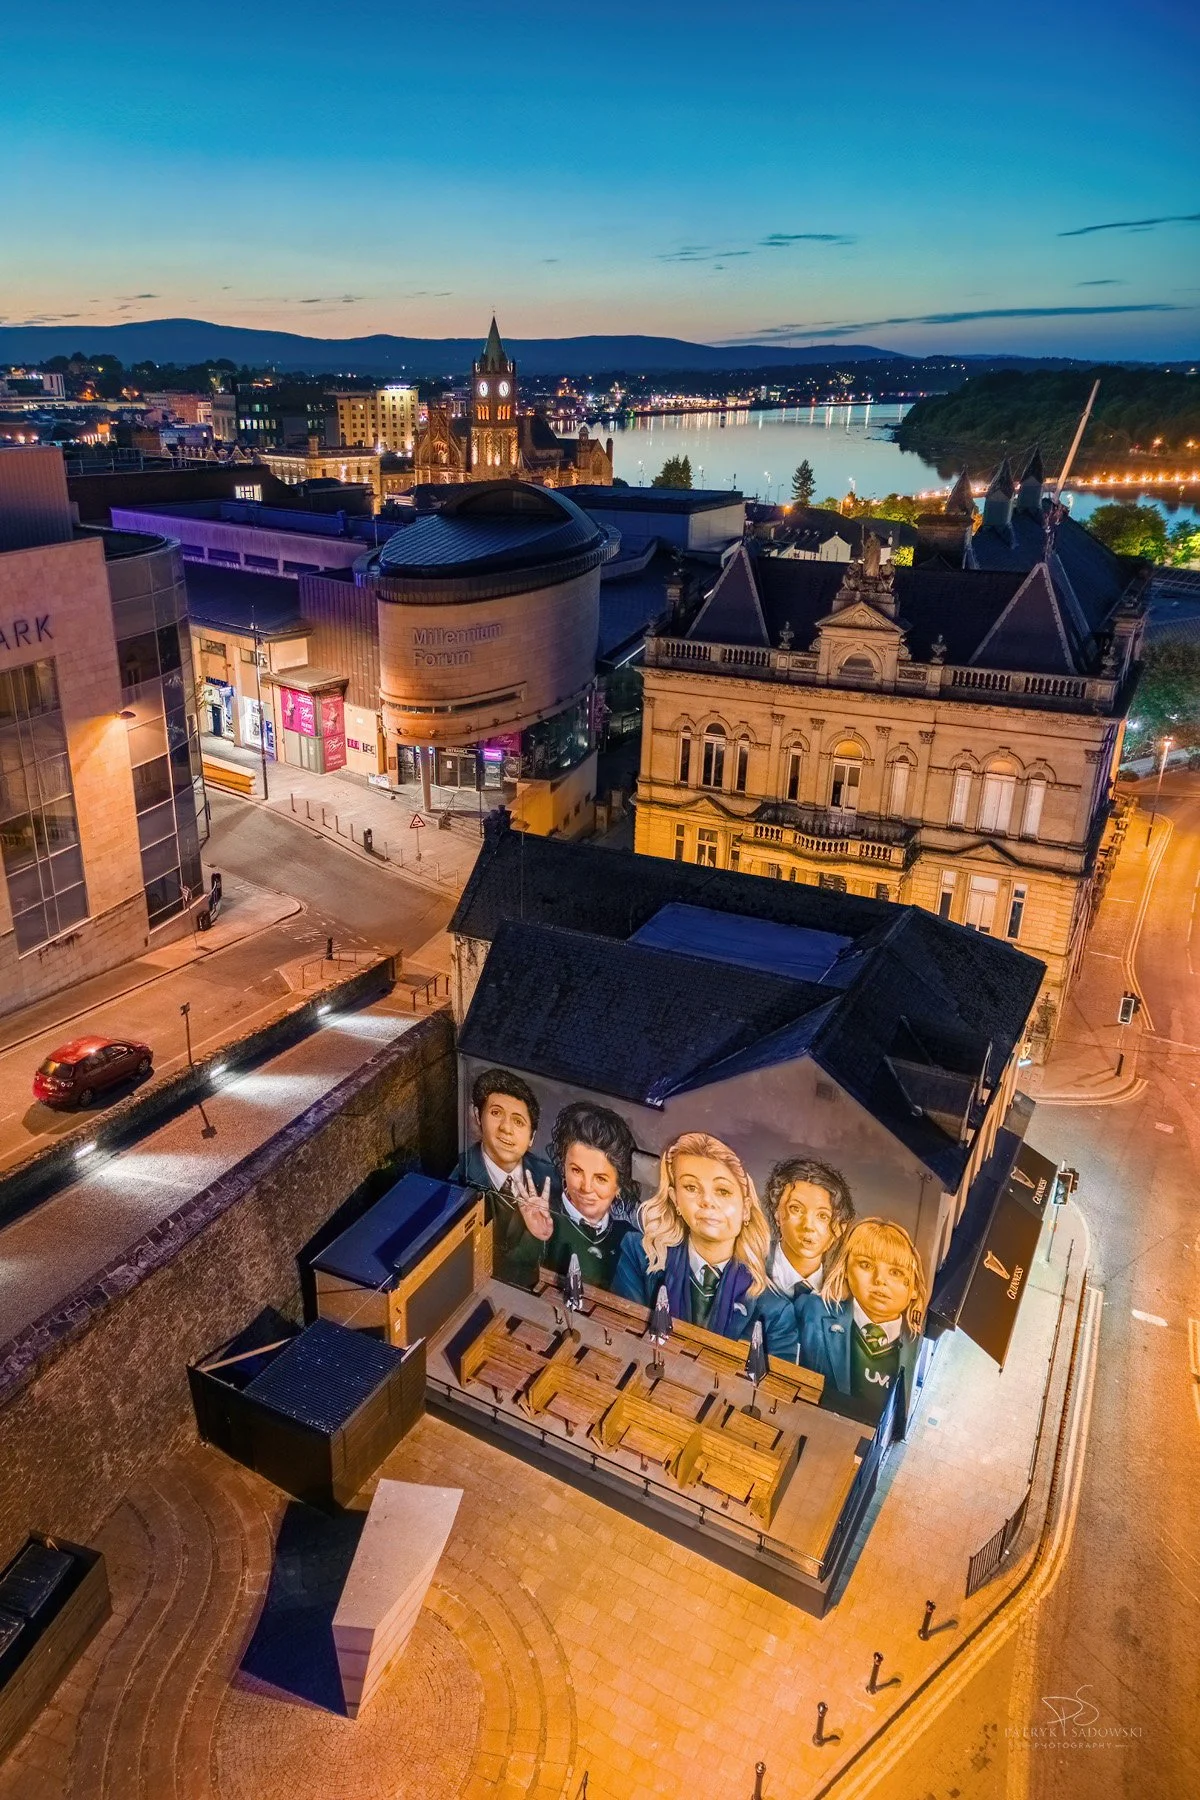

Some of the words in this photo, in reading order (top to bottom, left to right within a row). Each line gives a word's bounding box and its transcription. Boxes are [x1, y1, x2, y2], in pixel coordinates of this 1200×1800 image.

[412, 623, 502, 645] Millennium
[413, 648, 472, 666] Forum
[1007, 1265, 1024, 1300] GUINNESS
